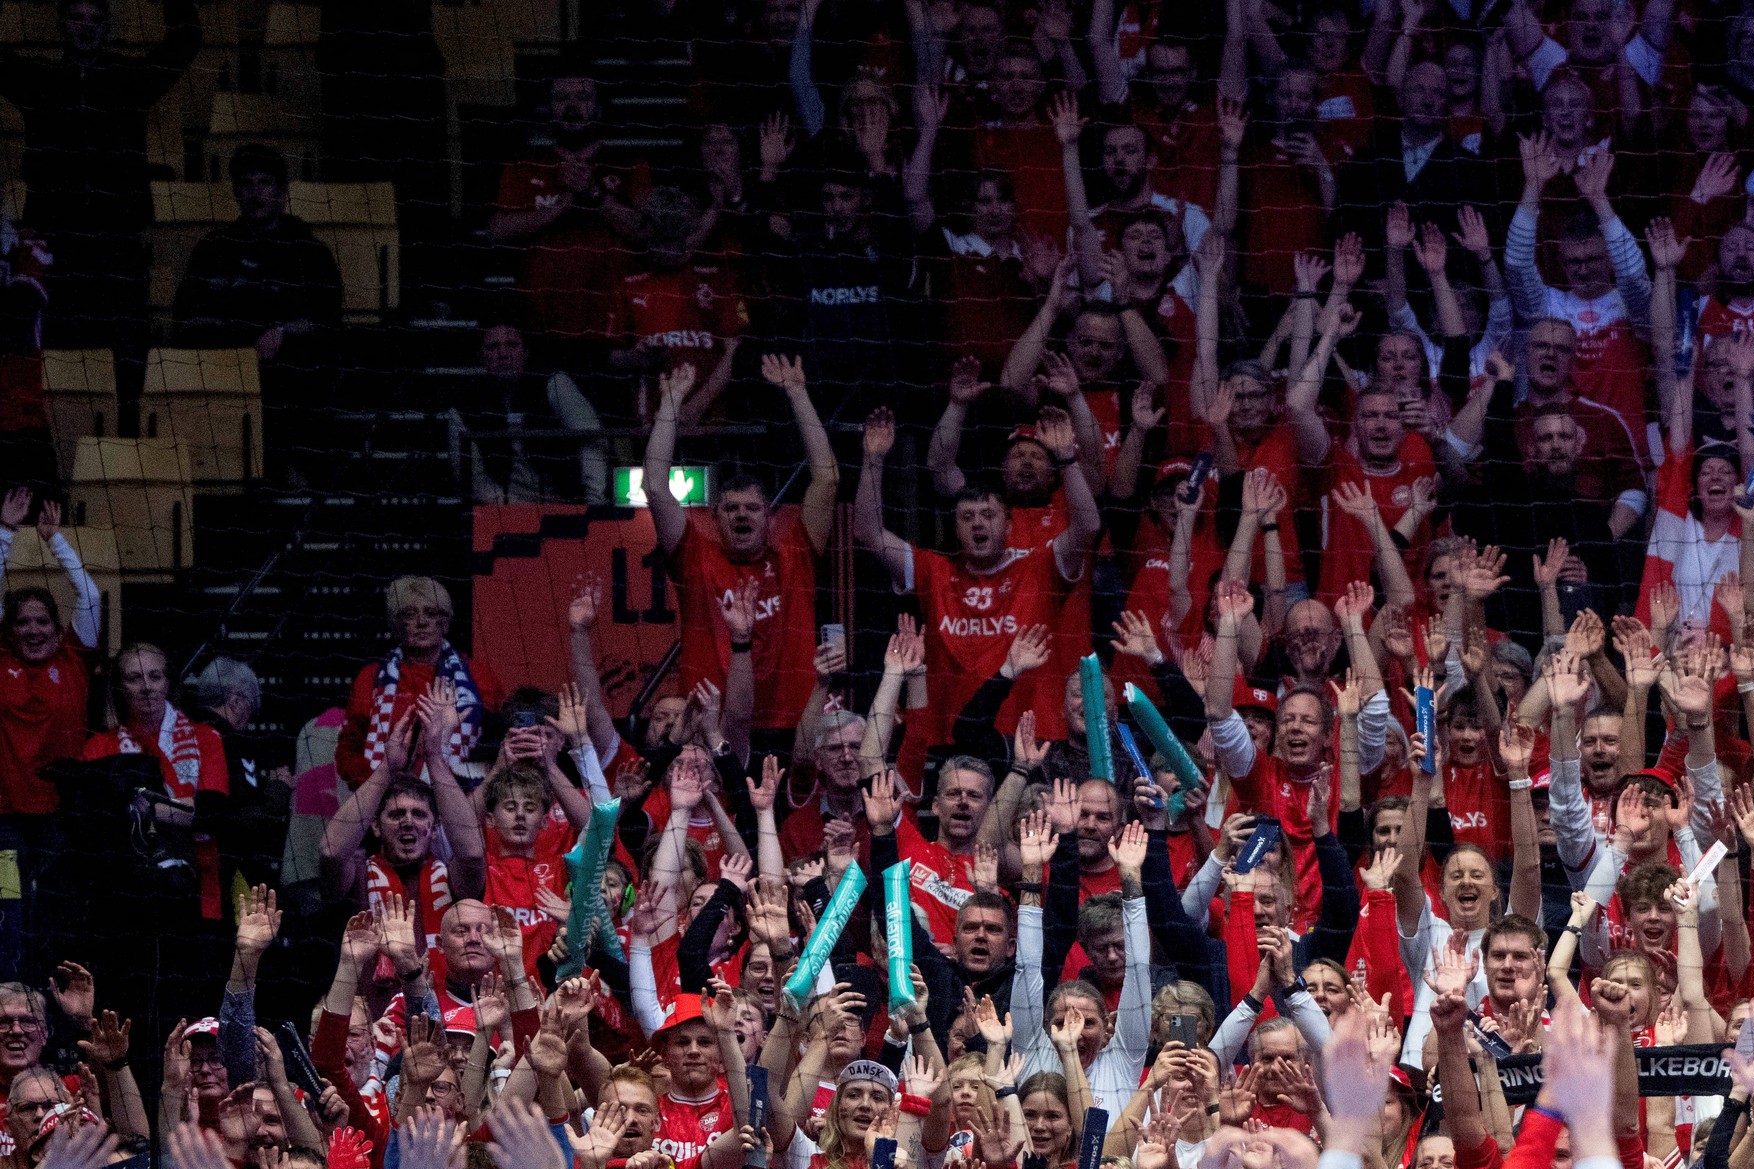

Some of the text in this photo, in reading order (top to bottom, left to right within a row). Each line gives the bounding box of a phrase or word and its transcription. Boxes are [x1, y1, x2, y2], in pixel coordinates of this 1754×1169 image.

[811, 285, 879, 306] NORLYS
[939, 615, 1018, 636] NORLYS
[848, 1065, 885, 1078] DANSK
